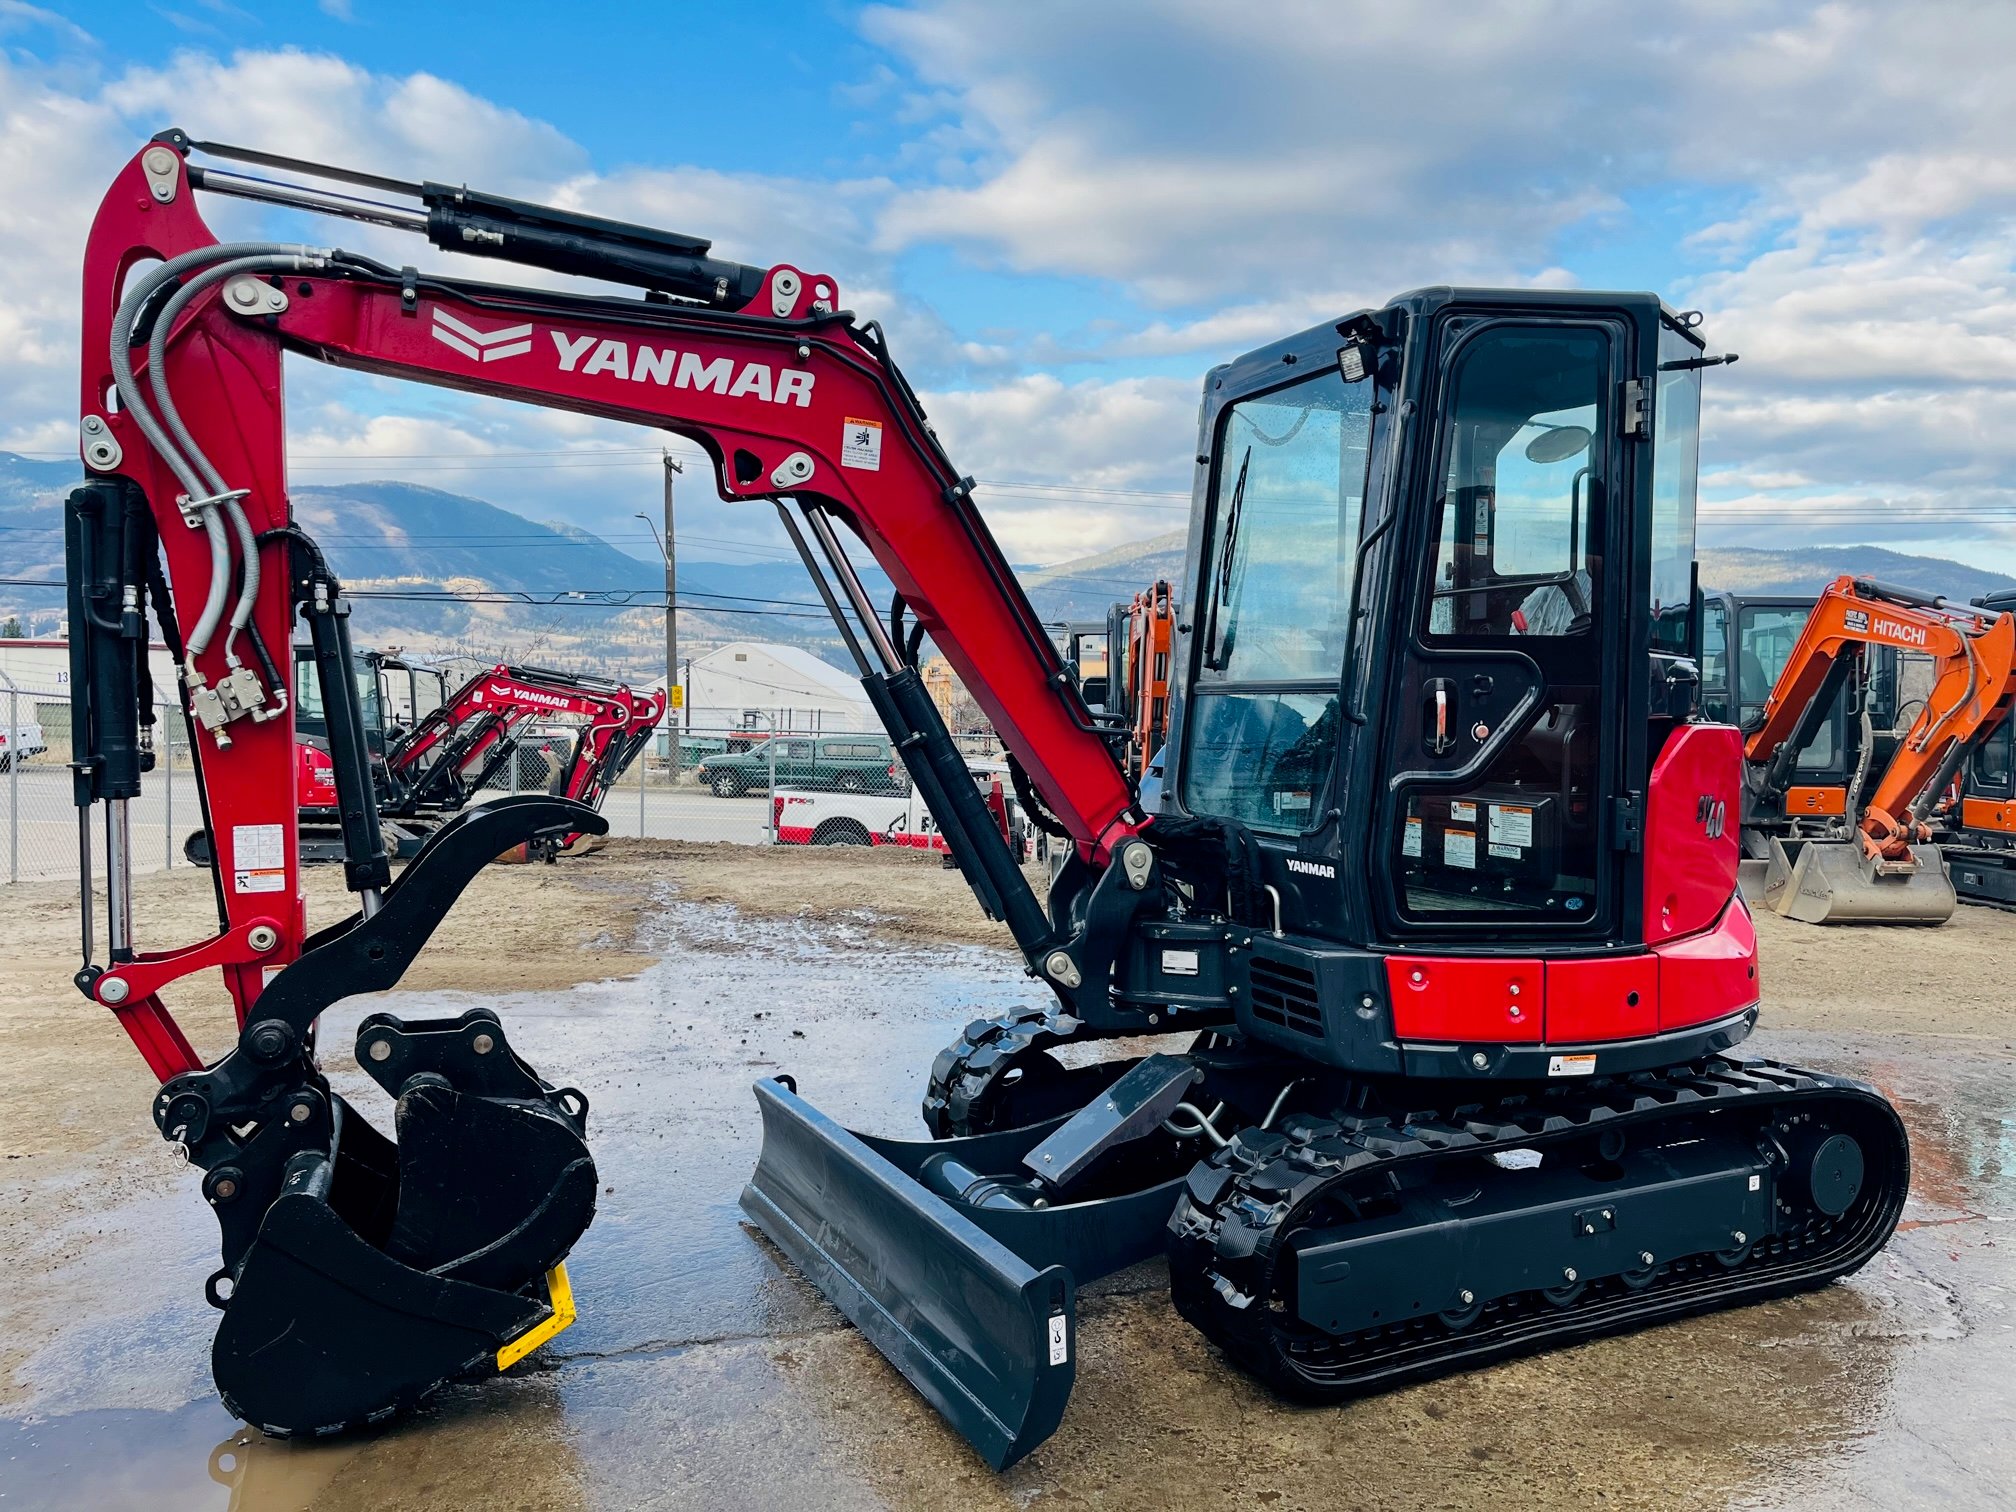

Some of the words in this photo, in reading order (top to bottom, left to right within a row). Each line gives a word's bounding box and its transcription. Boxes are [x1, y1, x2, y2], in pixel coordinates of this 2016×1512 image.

[550, 330, 815, 407] YANMAR
[1873, 618, 1926, 645] HITACHI
[513, 688, 570, 708] YANMAR
[1286, 858, 1335, 879] YANMAR
